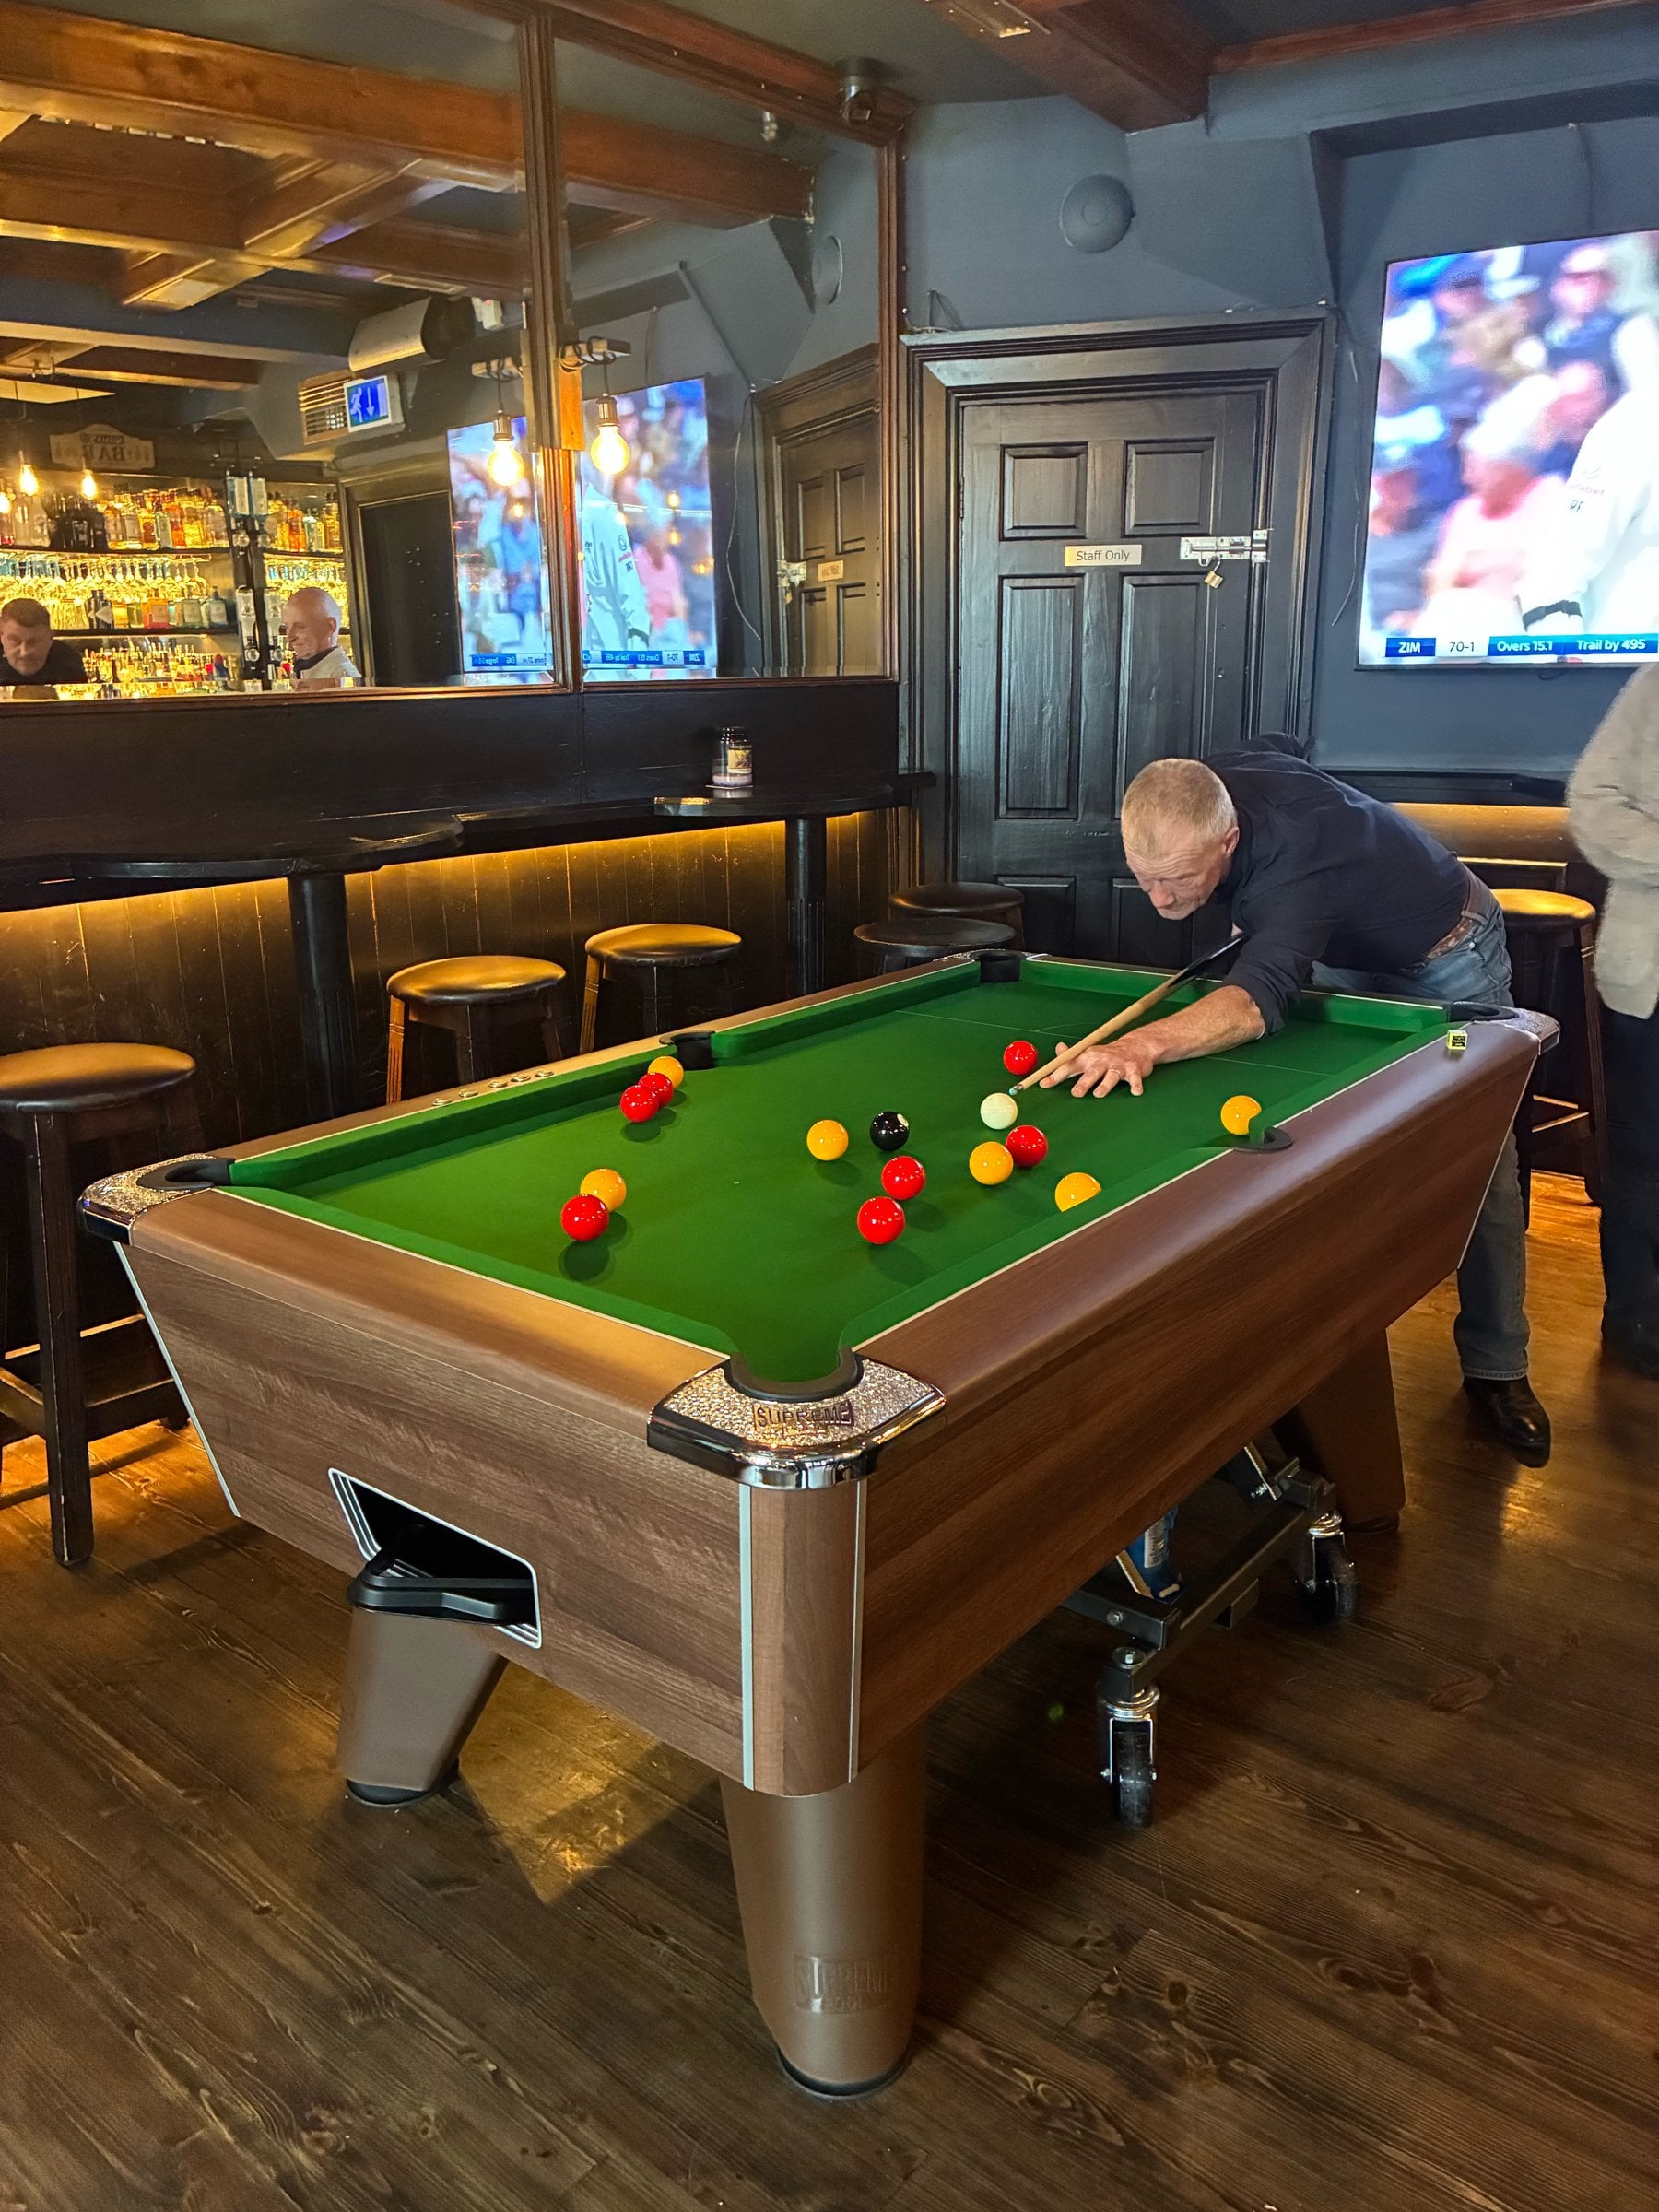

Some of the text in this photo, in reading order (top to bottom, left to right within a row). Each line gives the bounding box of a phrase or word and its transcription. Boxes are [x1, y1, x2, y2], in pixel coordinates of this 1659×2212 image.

[1076, 549, 1130, 562] Staff Only
[1398, 639, 1646, 653] ZIM 70-1 Overs 15.1 Trail by 495
[757, 1401, 852, 1427] SUPREME
